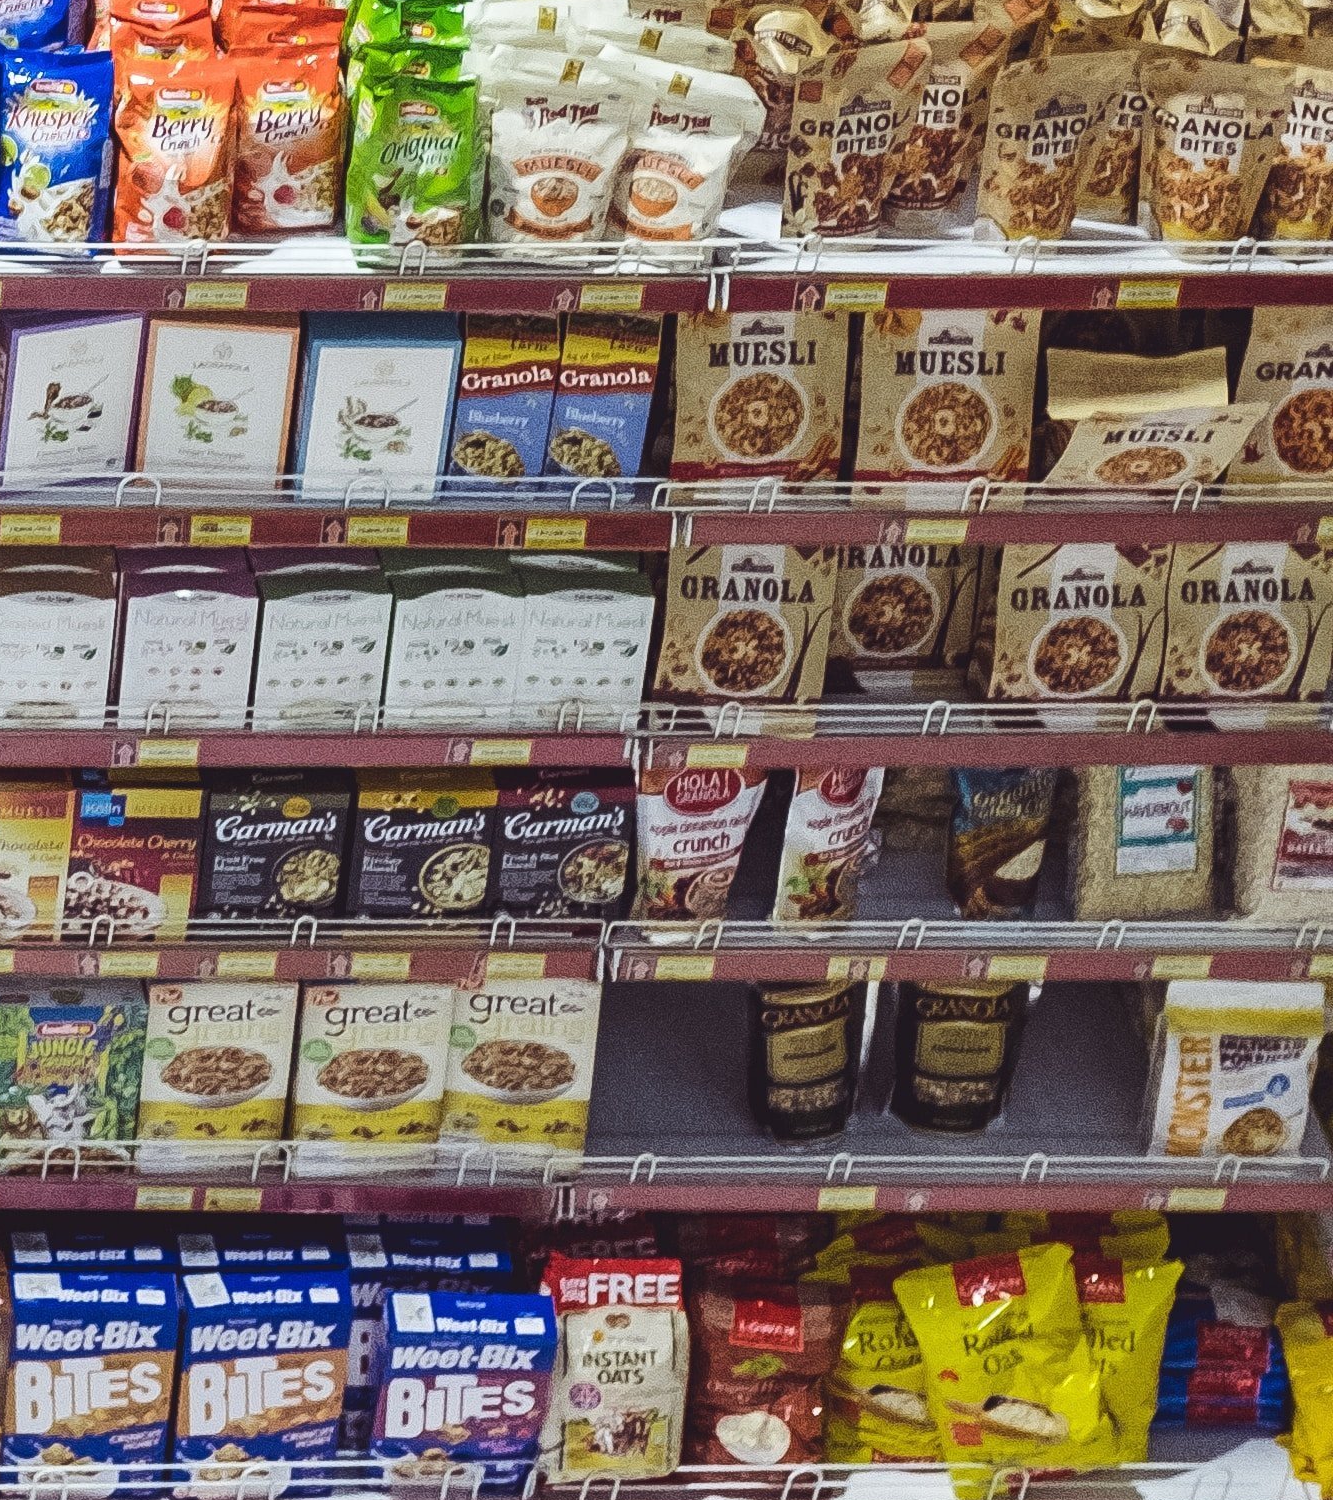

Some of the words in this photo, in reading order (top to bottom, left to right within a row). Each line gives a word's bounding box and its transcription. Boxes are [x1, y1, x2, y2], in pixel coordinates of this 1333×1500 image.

[7, 105, 96, 131] Knusper
[151, 114, 216, 139] Berry
[255, 105, 324, 134] Berry
[1154, 108, 1275, 139] GRANOLA
[159, 132, 202, 152] Crunch
[264, 125, 310, 142] Crunch
[380, 132, 462, 165] Original
[1180, 139, 1237, 157] BITES
[707, 341, 818, 367] MUESLI
[894, 350, 1006, 376] MUESLI
[460, 366, 555, 393] Granola
[558, 366, 654, 388] Granola
[467, 409, 529, 429] Blueberry
[564, 405, 626, 430] Blueberry
[1102, 427, 1216, 446] MUESLI
[680, 575, 815, 603] GRANOLA
[1010, 584, 1147, 612] GRANOLA
[1180, 578, 1317, 605] GRANOLA
[675, 772, 729, 794] HOLA!
[214, 811, 339, 841] Carman's
[362, 812, 488, 842] Carman's
[503, 810, 626, 838] Carman's
[136, 834, 198, 853] Cherry
[672, 832, 731, 856] crunch
[166, 1002, 258, 1035] great
[323, 1004, 415, 1037] great
[467, 991, 557, 1024] great
[28, 1038, 95, 1060] JUNGLE
[586, 1272, 681, 1304] FREE
[14, 1321, 163, 1353] Weet-Bix
[190, 1320, 337, 1353] Weet-Bix
[961, 1323, 1034, 1356] Rolled
[391, 1345, 541, 1370] Weet-Bix
[581, 1351, 658, 1369] INSTANT
[983, 1349, 1024, 1376] Oats
[596, 1368, 645, 1387] OATS
[13, 1357, 163, 1436] BITES
[186, 1358, 335, 1437] BITES
[383, 1375, 537, 1439] BITES
